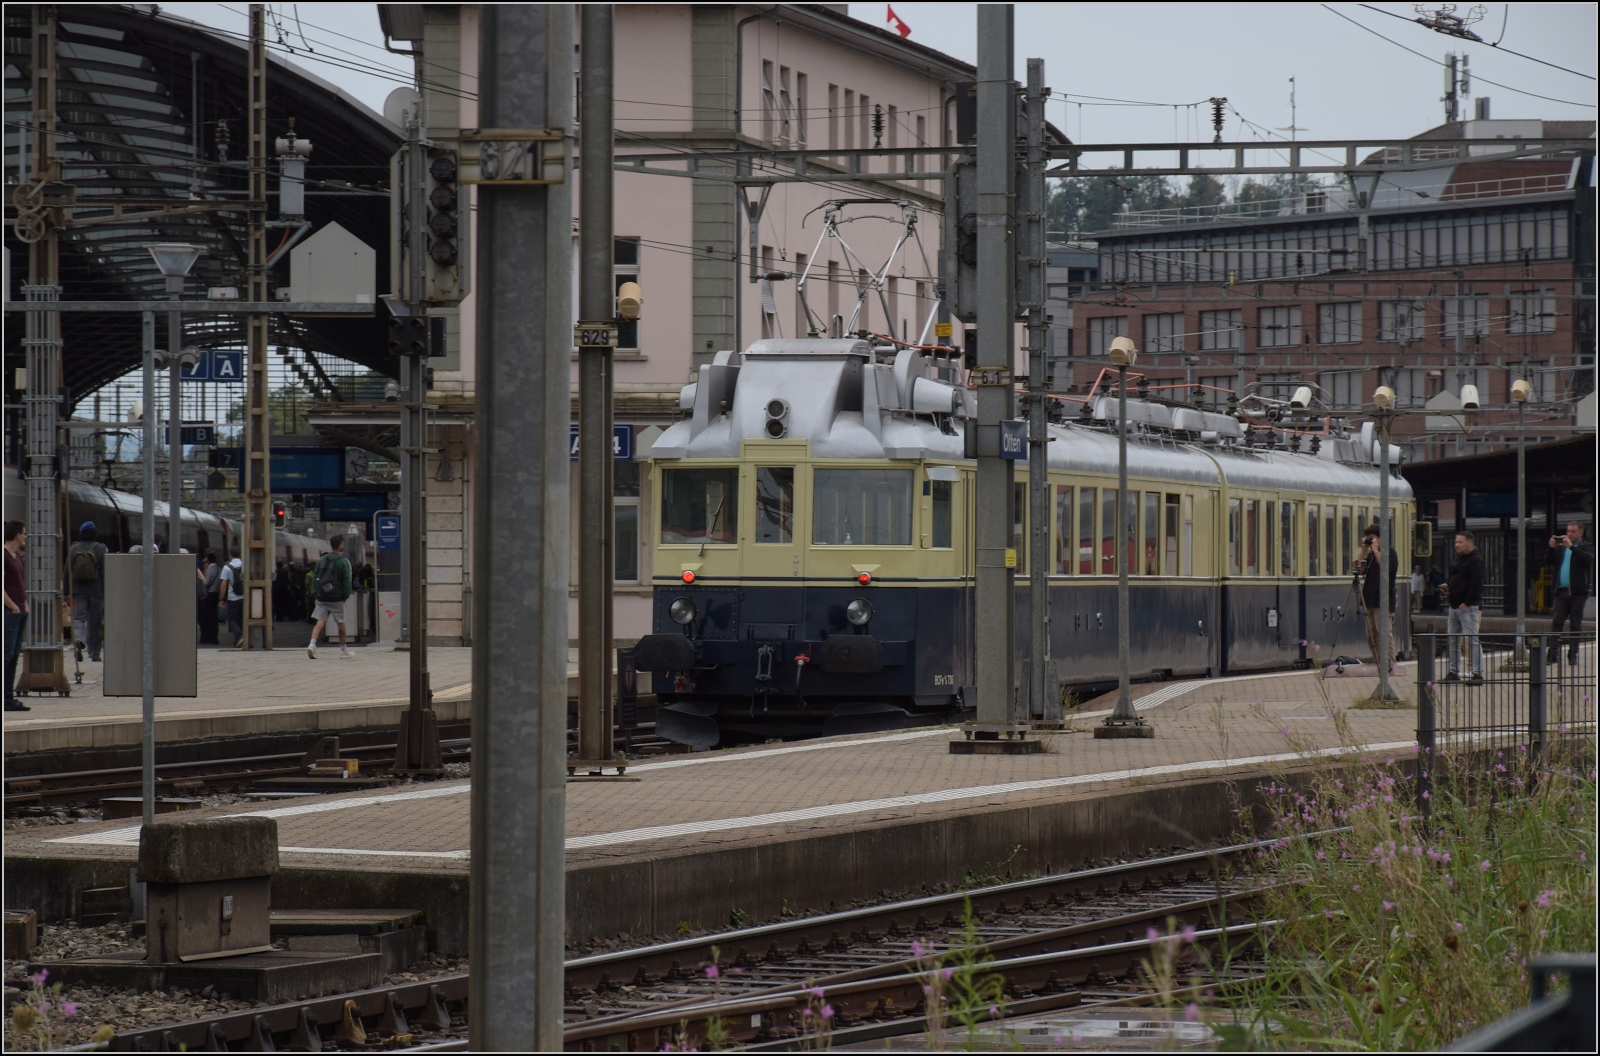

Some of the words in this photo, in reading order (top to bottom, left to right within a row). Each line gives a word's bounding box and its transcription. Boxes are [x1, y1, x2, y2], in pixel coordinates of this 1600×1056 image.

[480, 140, 541, 180] 621
[581, 329, 609, 345] 629
[220, 360, 235, 376] A
[196, 428, 207, 441] B
[1003, 432, 1021, 453] Olten
[223, 454, 232, 465] 7
